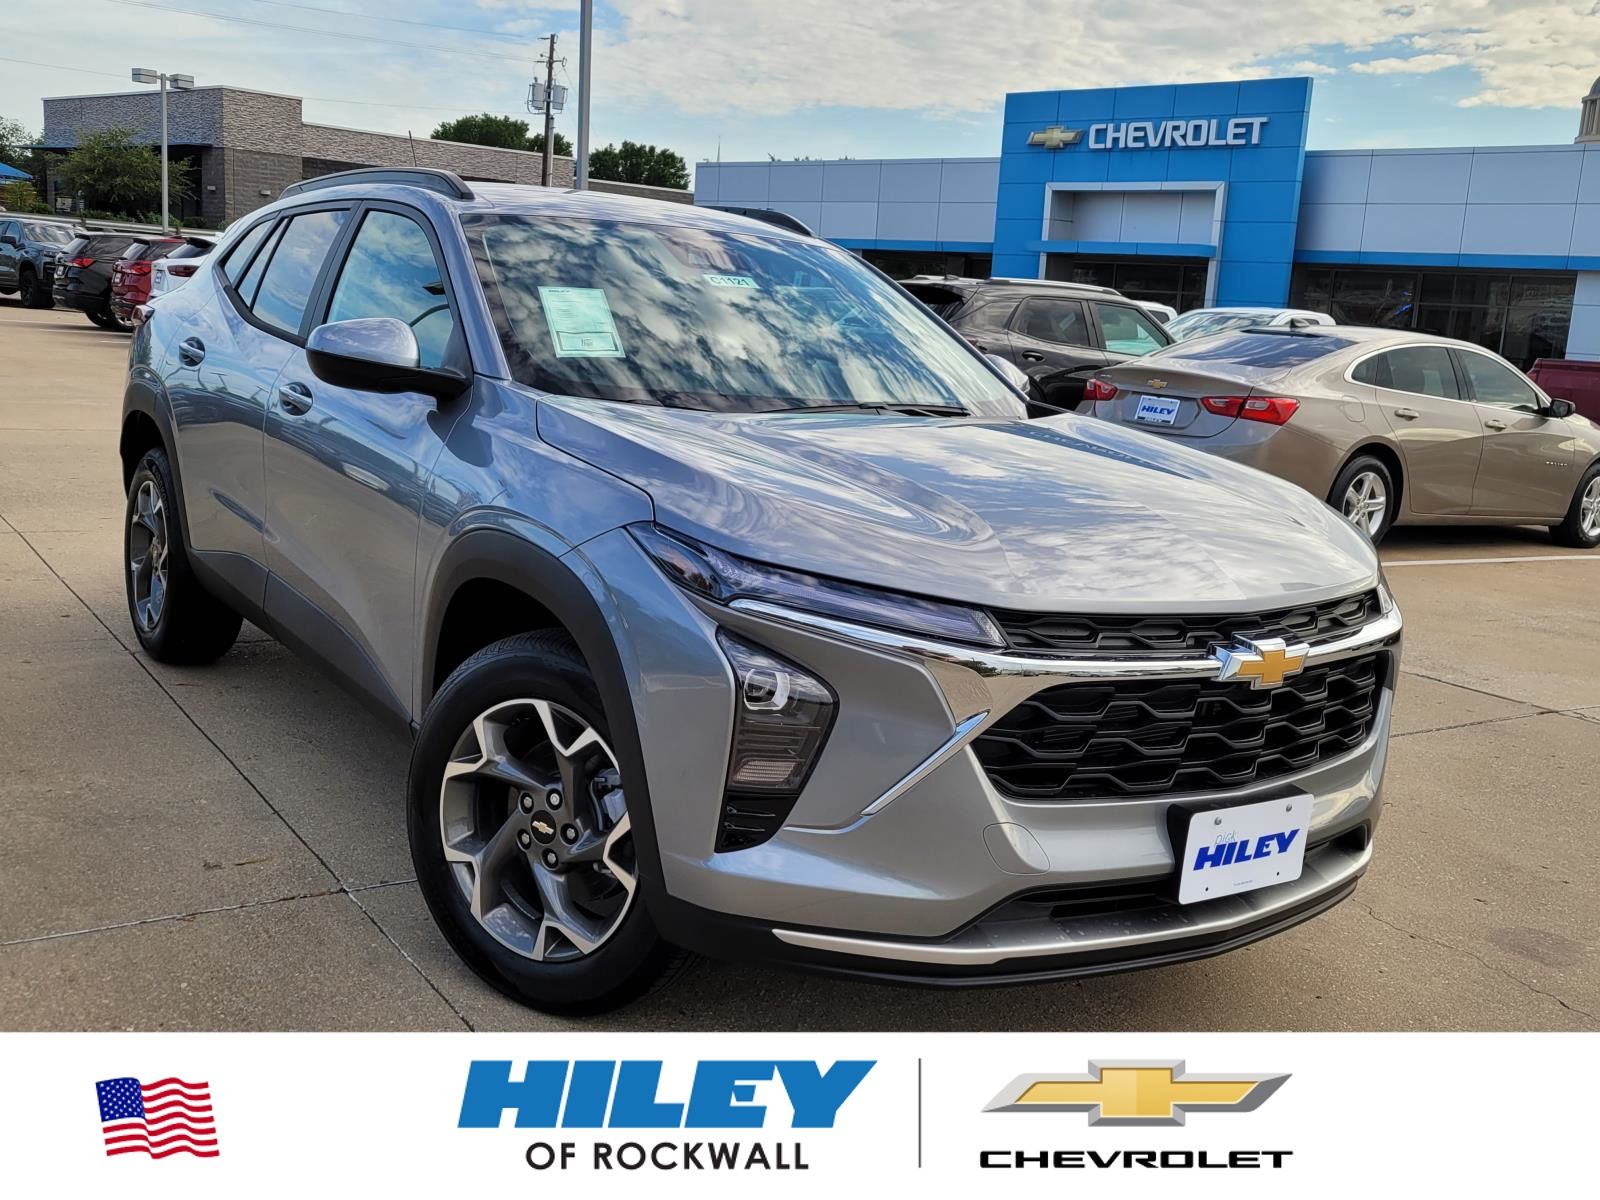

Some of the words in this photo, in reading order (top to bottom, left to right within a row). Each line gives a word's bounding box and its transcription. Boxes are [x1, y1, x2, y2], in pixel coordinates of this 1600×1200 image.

[1088, 116, 1268, 150] CHEVROLET
[710, 276, 751, 287] C1121
[1141, 405, 1174, 415] HILEY
[1193, 828, 1300, 871] HILEY
